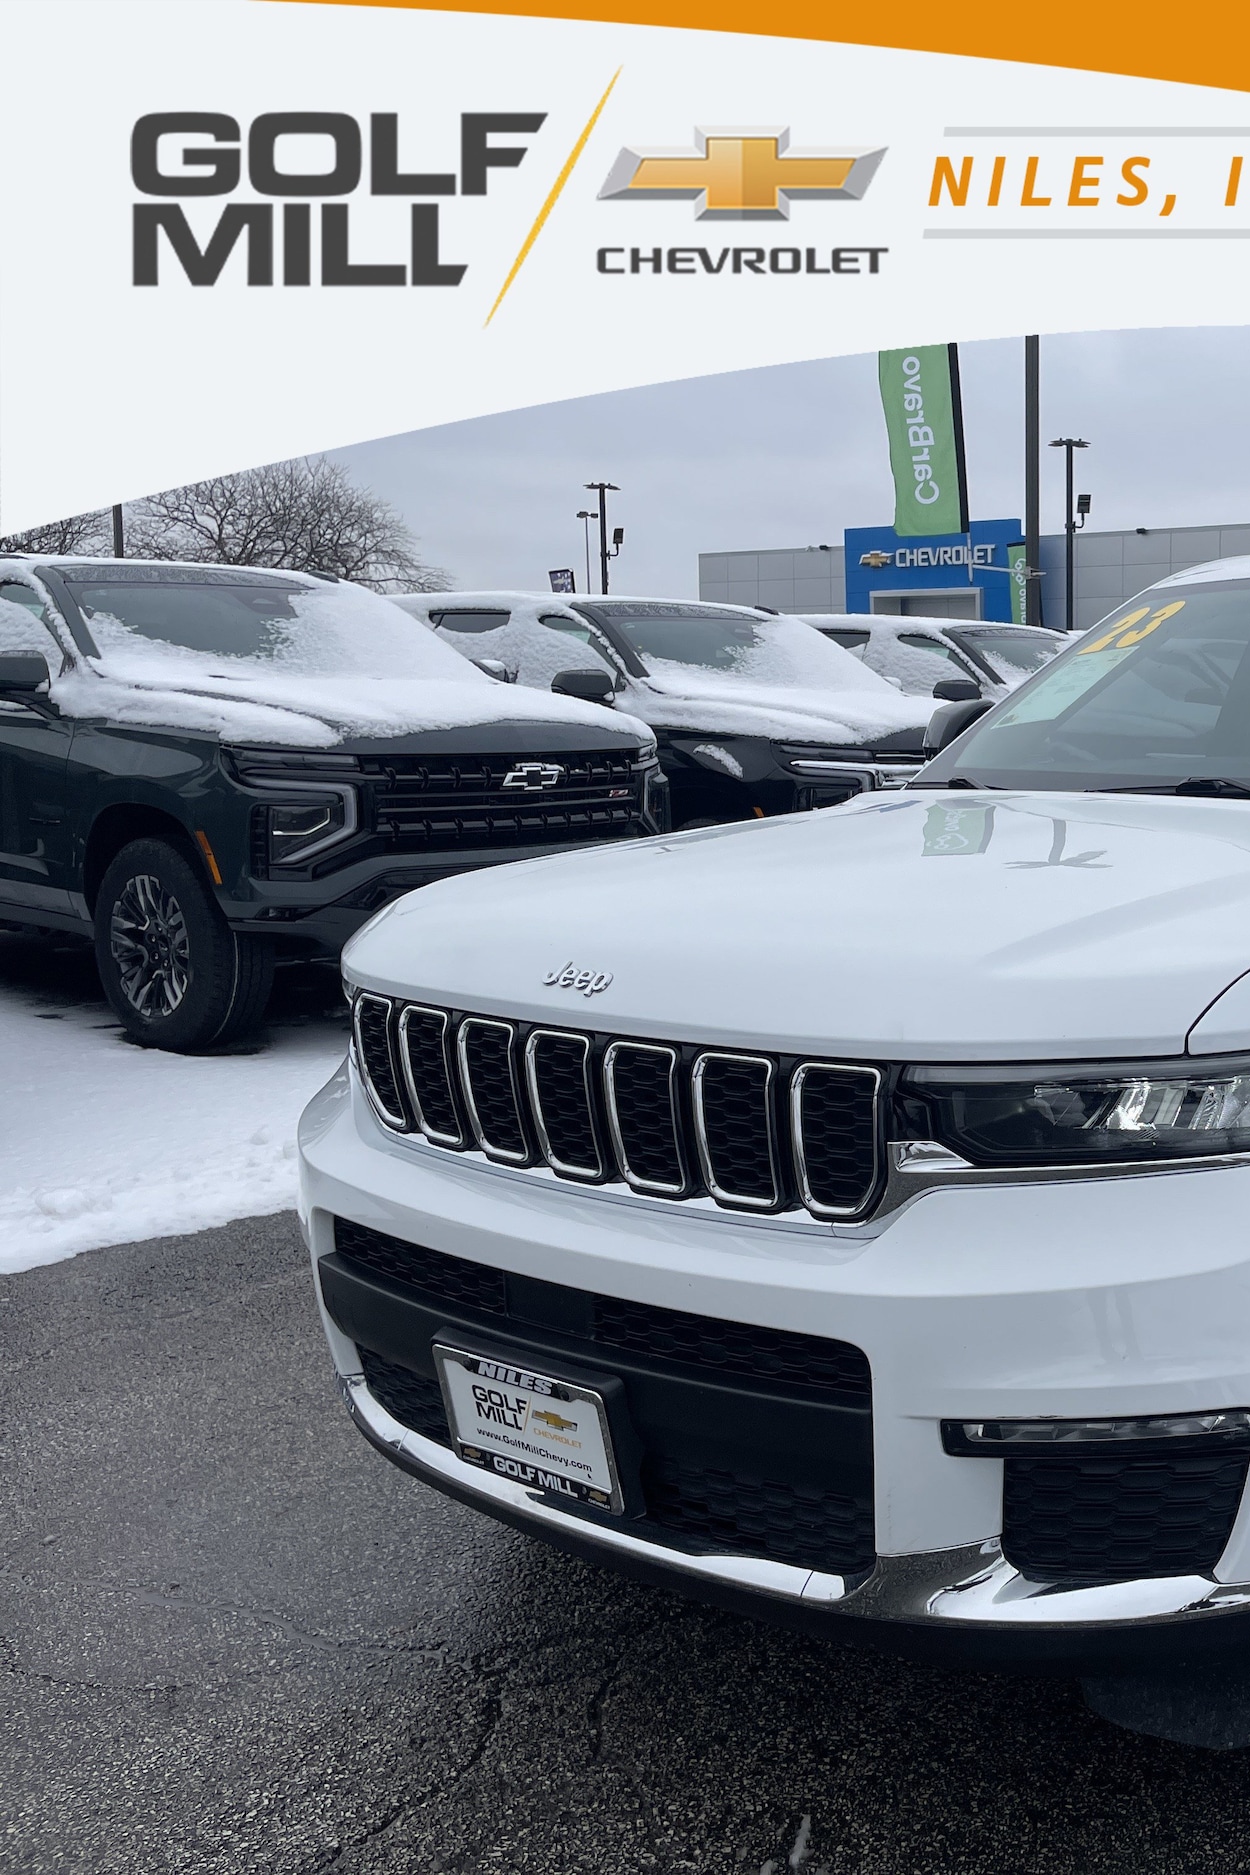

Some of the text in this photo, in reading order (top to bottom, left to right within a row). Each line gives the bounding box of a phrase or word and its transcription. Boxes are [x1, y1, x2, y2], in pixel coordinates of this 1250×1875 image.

[895, 543, 996, 568] CHEVROLET
[1076, 600, 1186, 656] 23
[542, 960, 614, 998] Jeep
[478, 1361, 552, 1396] NILES
[472, 1384, 527, 1415] GOLF
[475, 1401, 523, 1431] MILL
[476, 1428, 593, 1473] www.GolfMillChevy.com
[533, 1427, 582, 1449] CHEVROLET
[493, 1455, 579, 1498] GOLF MILL
